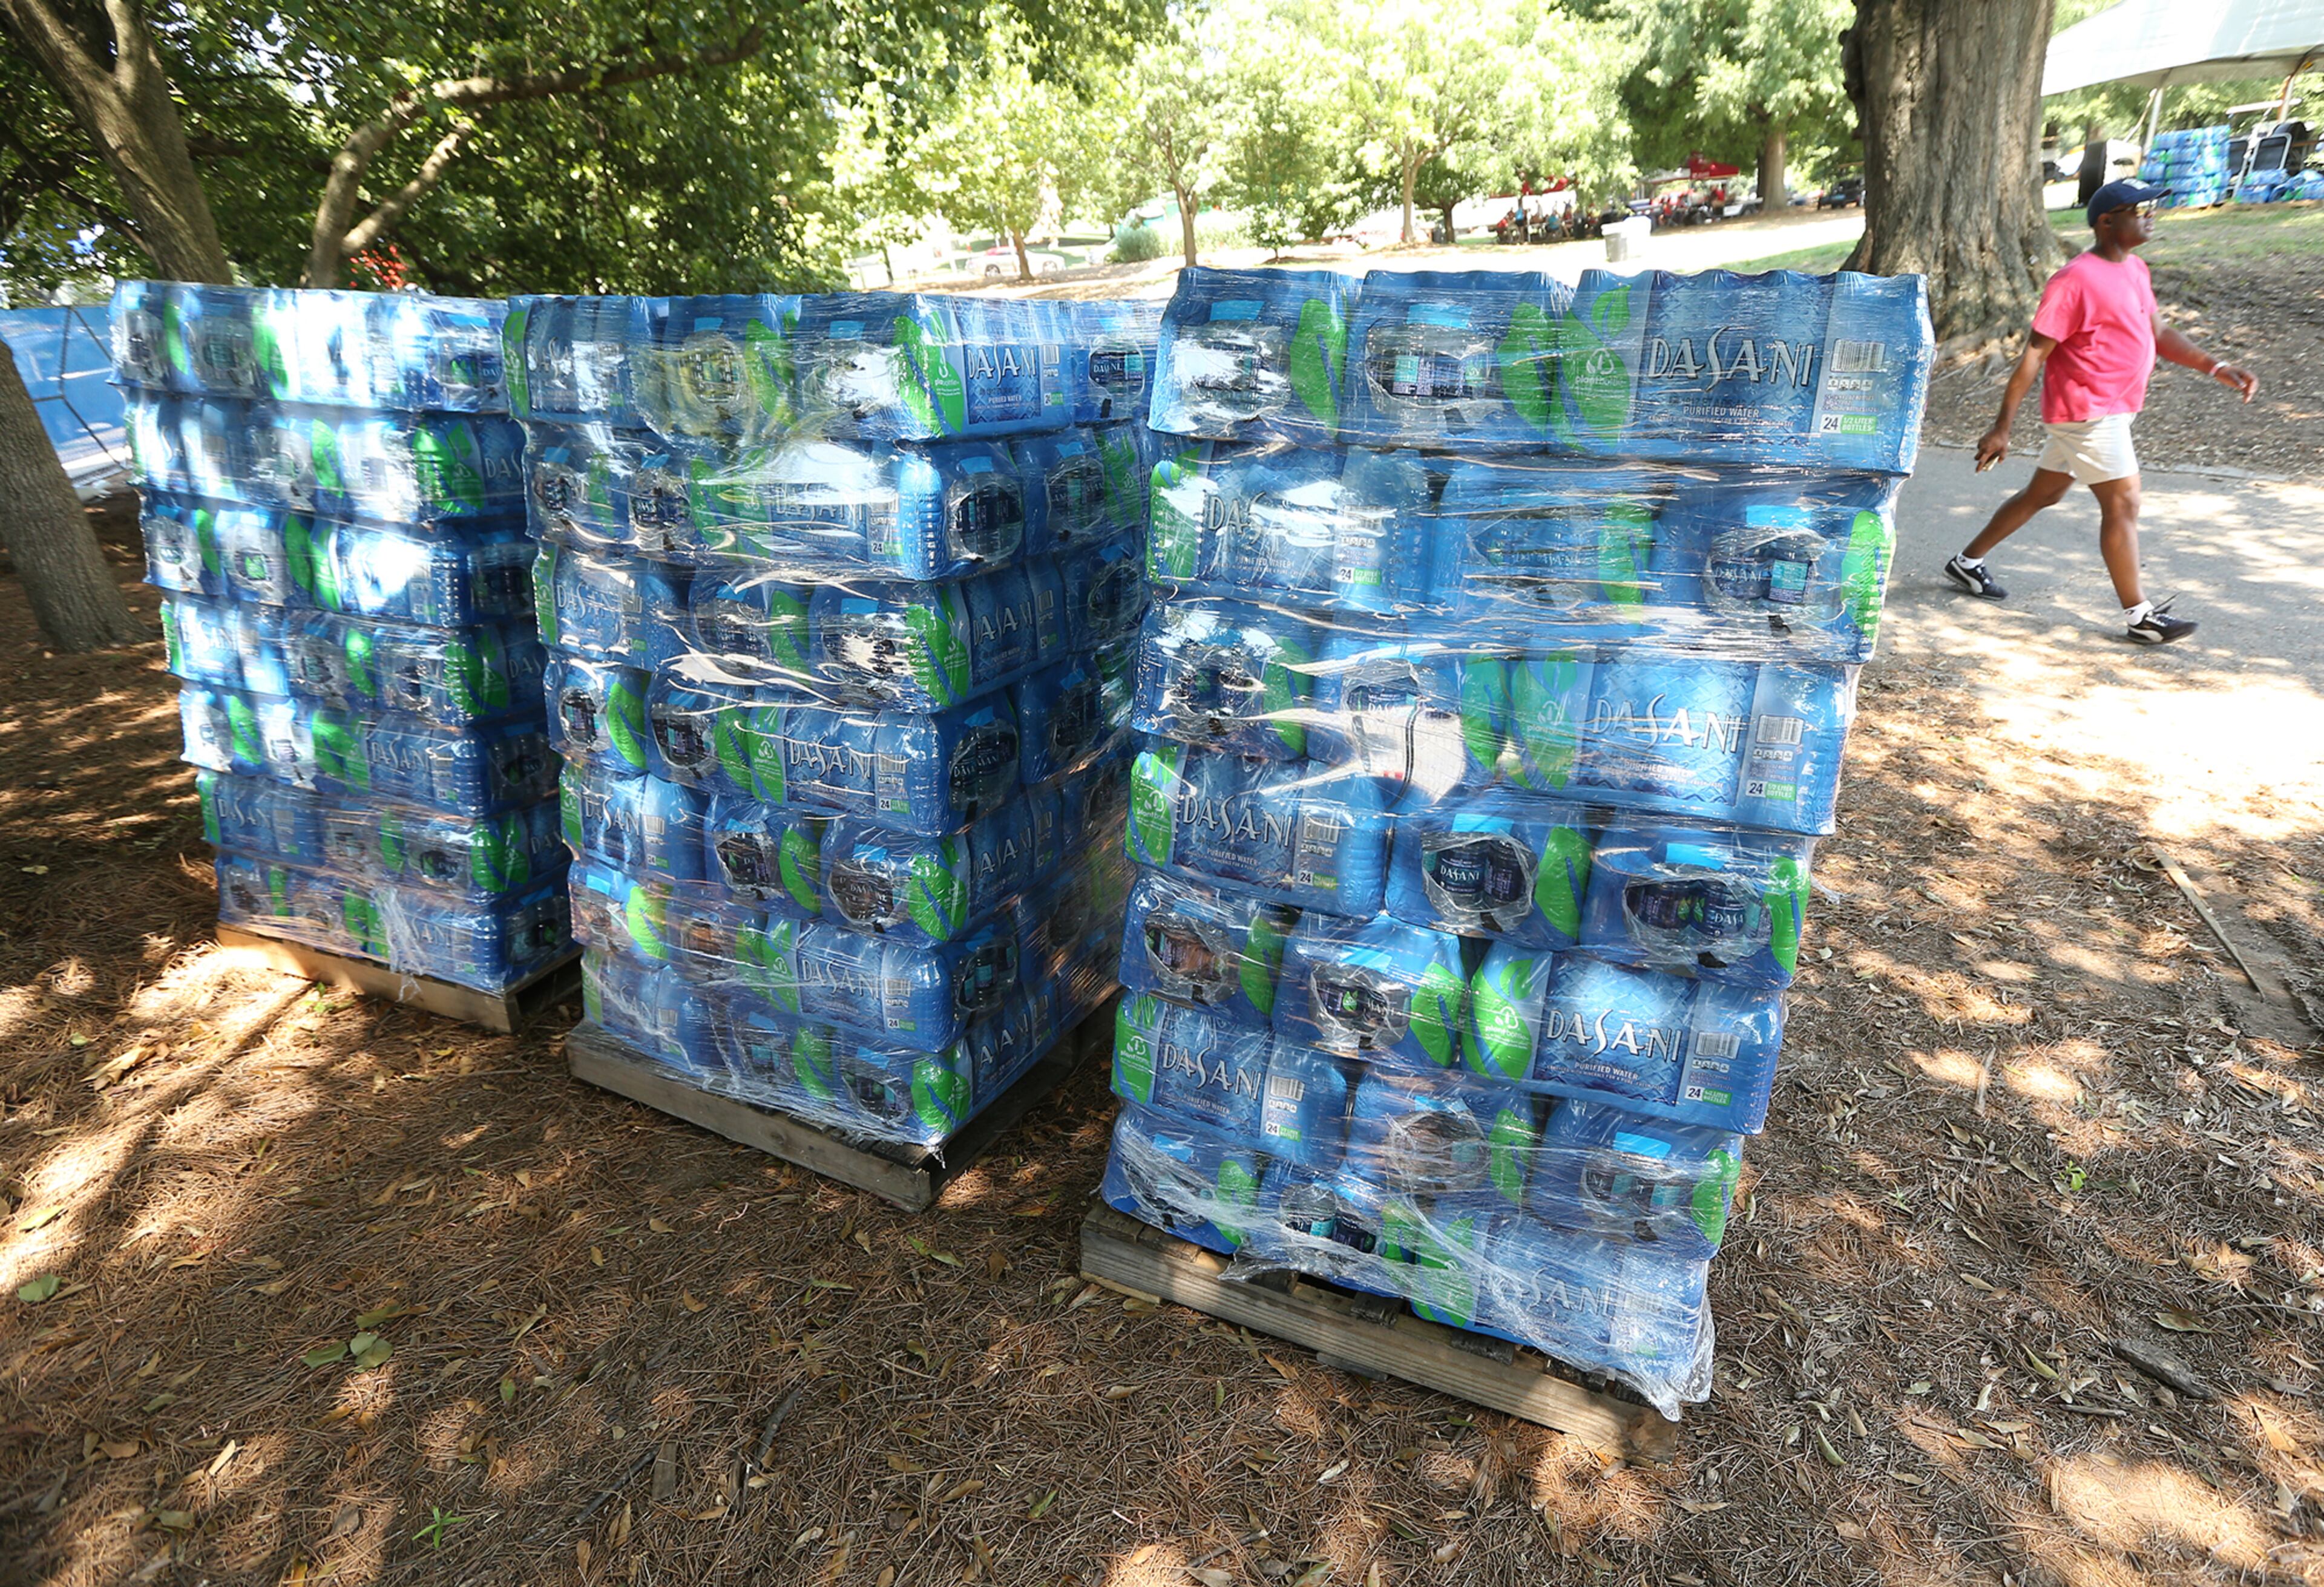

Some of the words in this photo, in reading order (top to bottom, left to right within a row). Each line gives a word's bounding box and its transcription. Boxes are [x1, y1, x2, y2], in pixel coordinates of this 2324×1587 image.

[968, 339, 1036, 386] DASANI
[1646, 326, 1814, 393] DASANI
[1683, 406, 1725, 416] PURIFIED
[1728, 407, 1760, 417] WATER
[1823, 417, 1839, 430] 24
[873, 543, 882, 553] 24
[1593, 693, 1742, 754] DASANI
[790, 734, 871, 779] DASANI
[1749, 782, 1763, 794] 24
[881, 799, 890, 808] 24
[1183, 795, 1292, 847] DASANI
[1300, 872, 1311, 883] 24
[1440, 865, 1480, 881] DASANI
[802, 958, 879, 1000] DASANI
[888, 1019, 898, 1027] 24
[1546, 1009, 1682, 1062] DASANI
[1162, 1043, 1262, 1101] DASANI
[1575, 1061, 1611, 1073] PURIFIED
[1612, 1068, 1640, 1081] WATER
[1687, 1087, 1701, 1098] 24
[1267, 1124, 1278, 1133] 24
